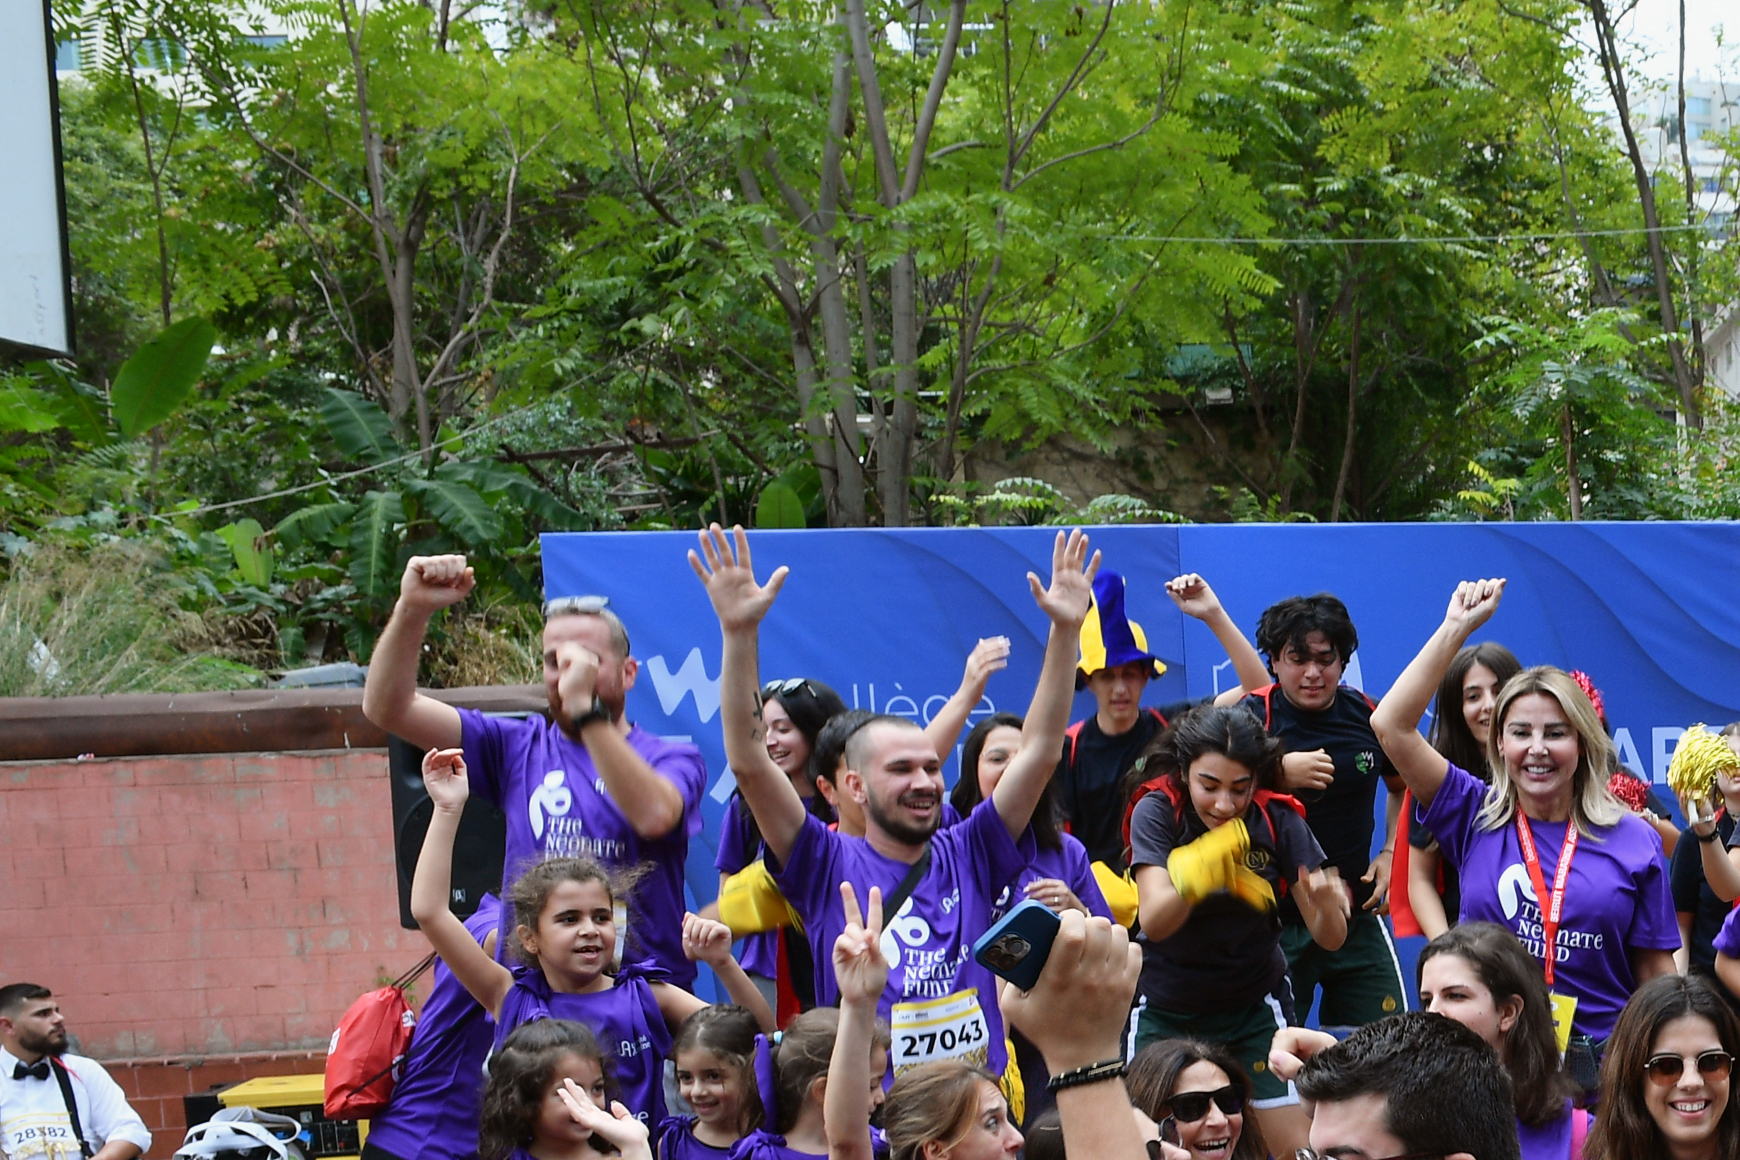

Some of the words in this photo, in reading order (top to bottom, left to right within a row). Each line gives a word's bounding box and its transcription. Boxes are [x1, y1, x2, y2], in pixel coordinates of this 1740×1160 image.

[1521, 901, 1544, 924] TH
[900, 1019, 983, 1058] 27043
[14, 1126, 69, 1145] 2882
